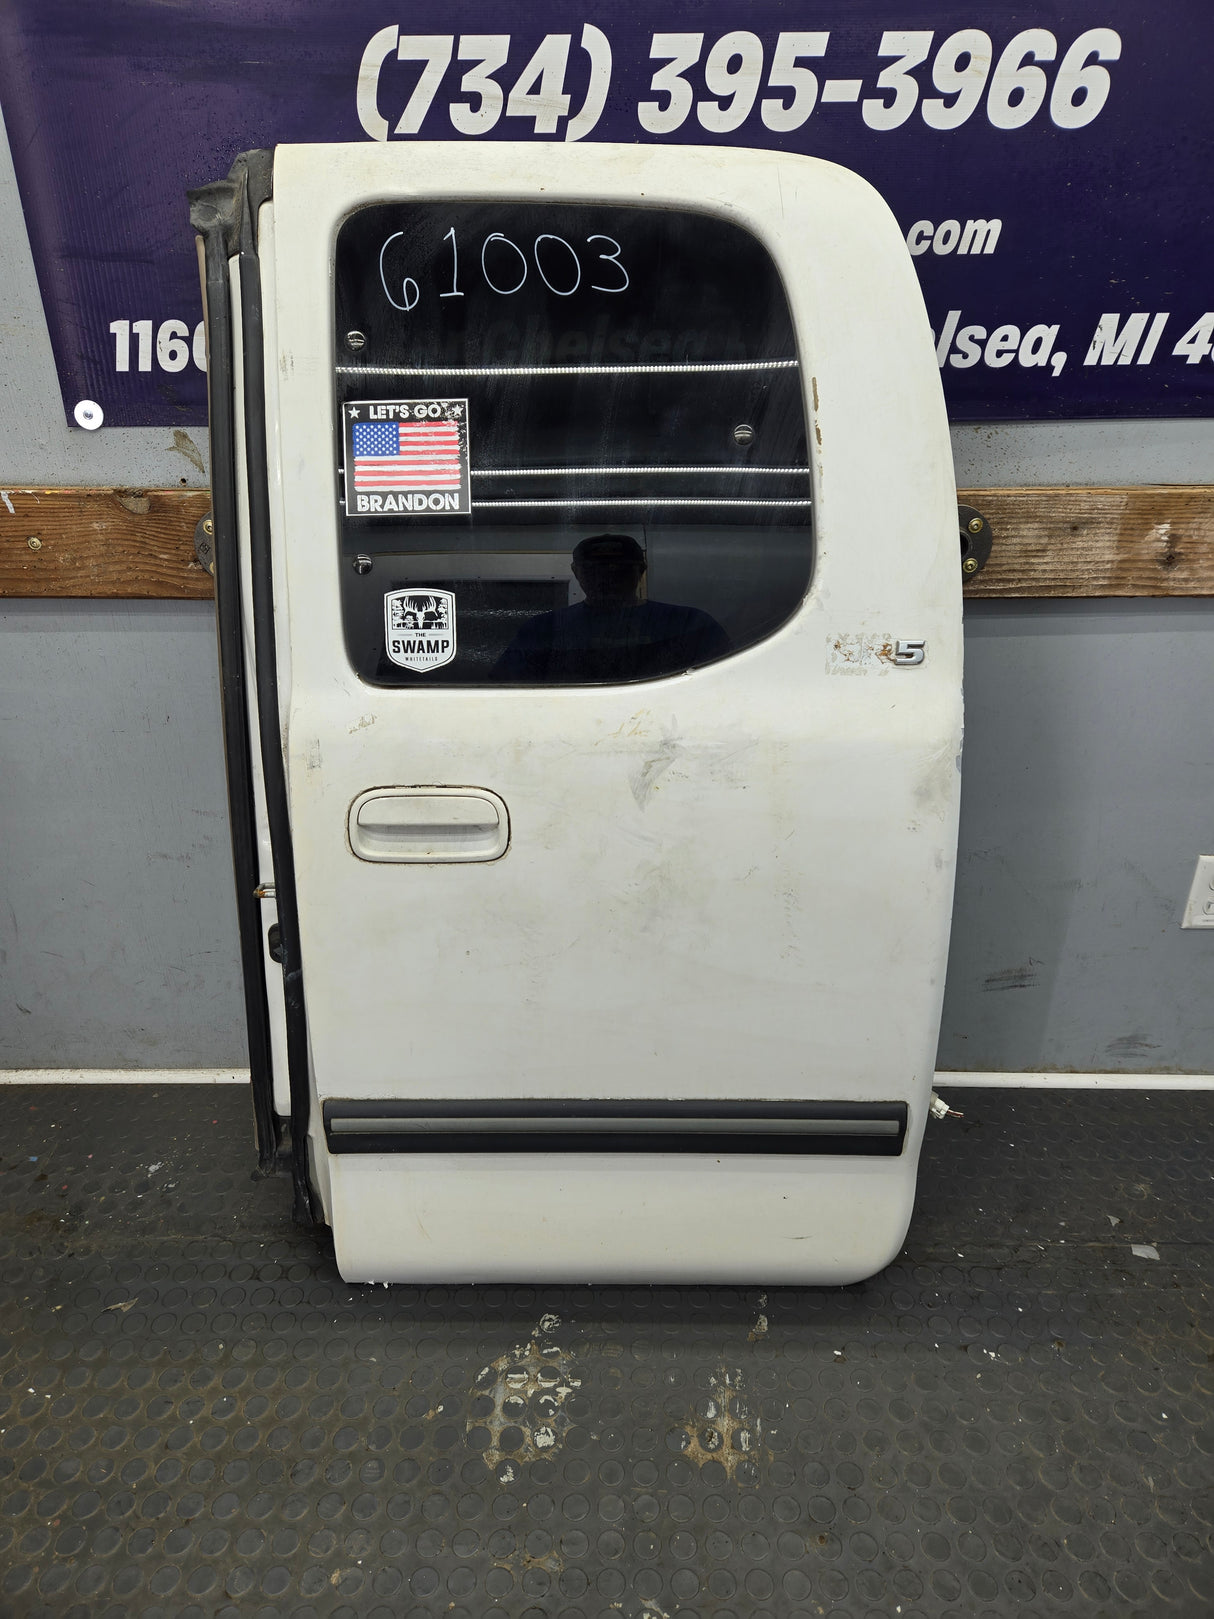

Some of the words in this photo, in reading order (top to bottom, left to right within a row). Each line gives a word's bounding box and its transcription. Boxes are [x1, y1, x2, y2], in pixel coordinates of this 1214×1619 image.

[356, 22, 612, 142] (734)
[637, 28, 1122, 134] 395-3966
[379, 226, 630, 312] 61003
[931, 310, 1068, 377] lsea,
[1083, 312, 1170, 366] MI
[1171, 312, 1214, 365] 4
[369, 404, 410, 419] LET'S
[413, 403, 442, 418] GO
[356, 493, 460, 511] BRANDON
[392, 639, 450, 654] SWAMP
